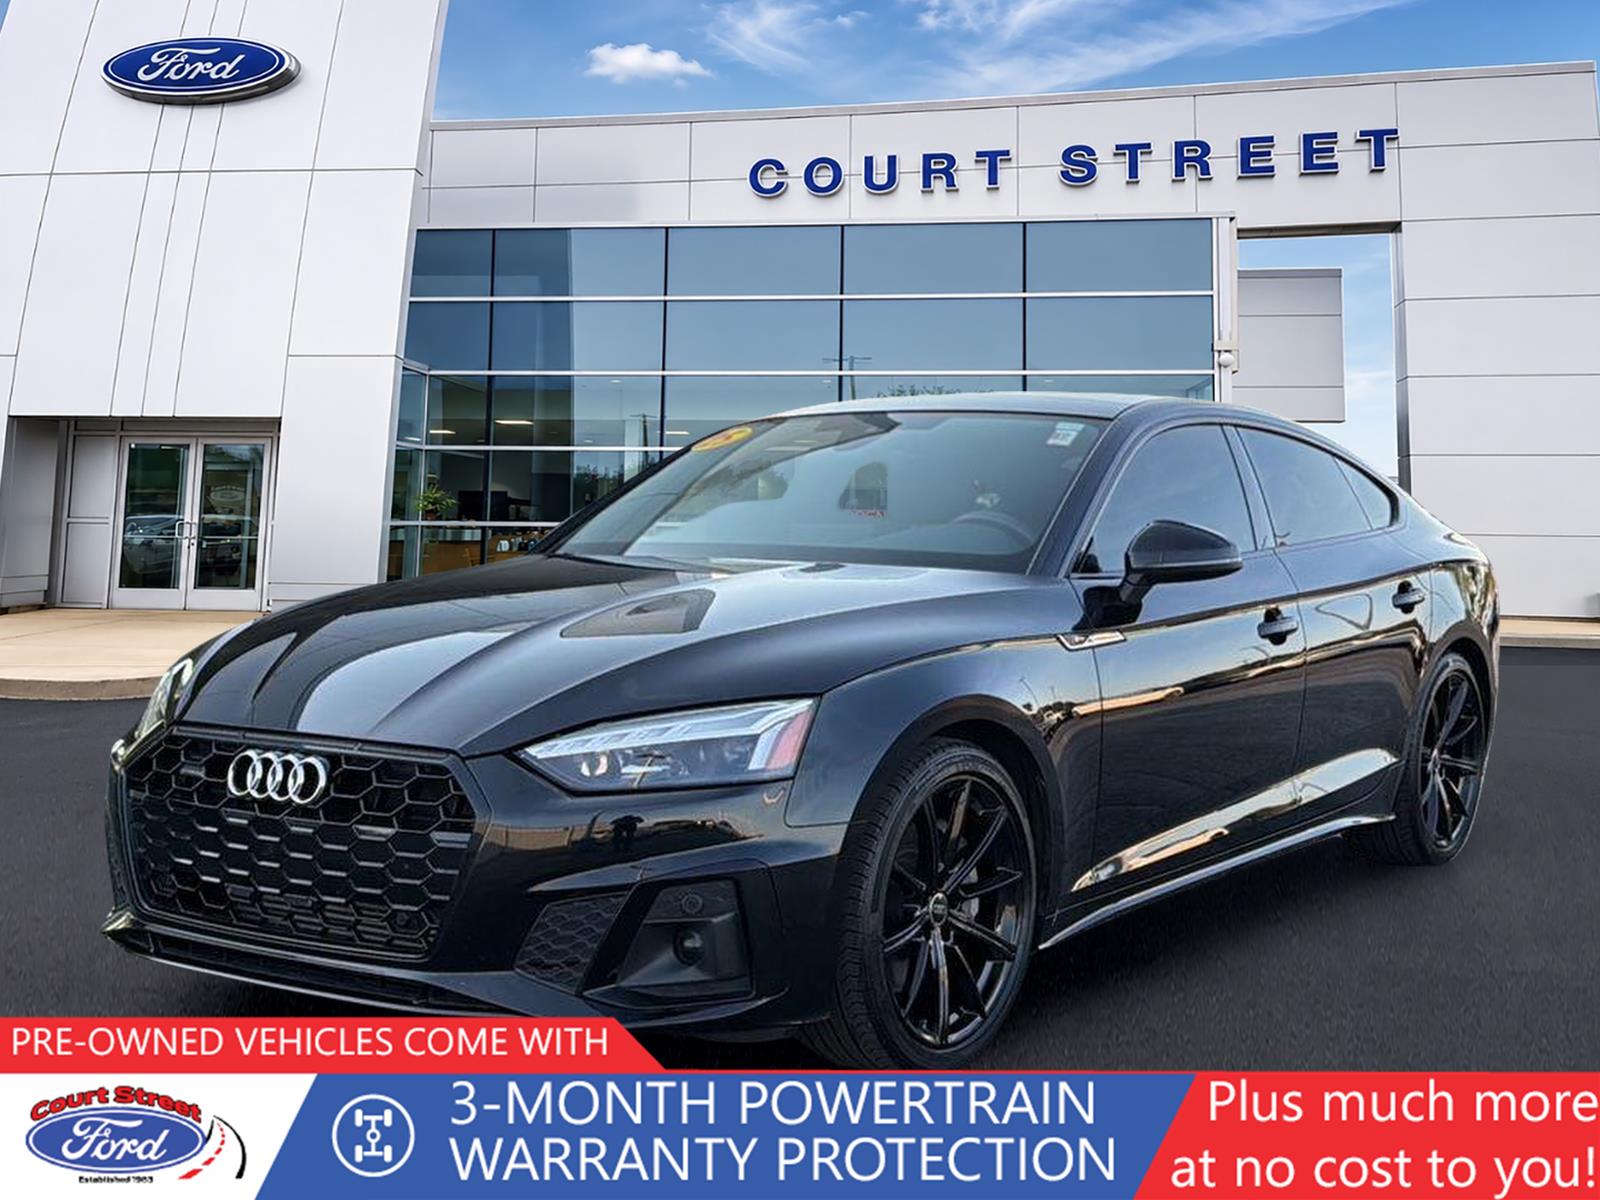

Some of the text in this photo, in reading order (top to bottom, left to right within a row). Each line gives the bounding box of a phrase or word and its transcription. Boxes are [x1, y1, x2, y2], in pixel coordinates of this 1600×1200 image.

[137, 47, 246, 81] Ford
[748, 127, 1399, 197] COURT STREET
